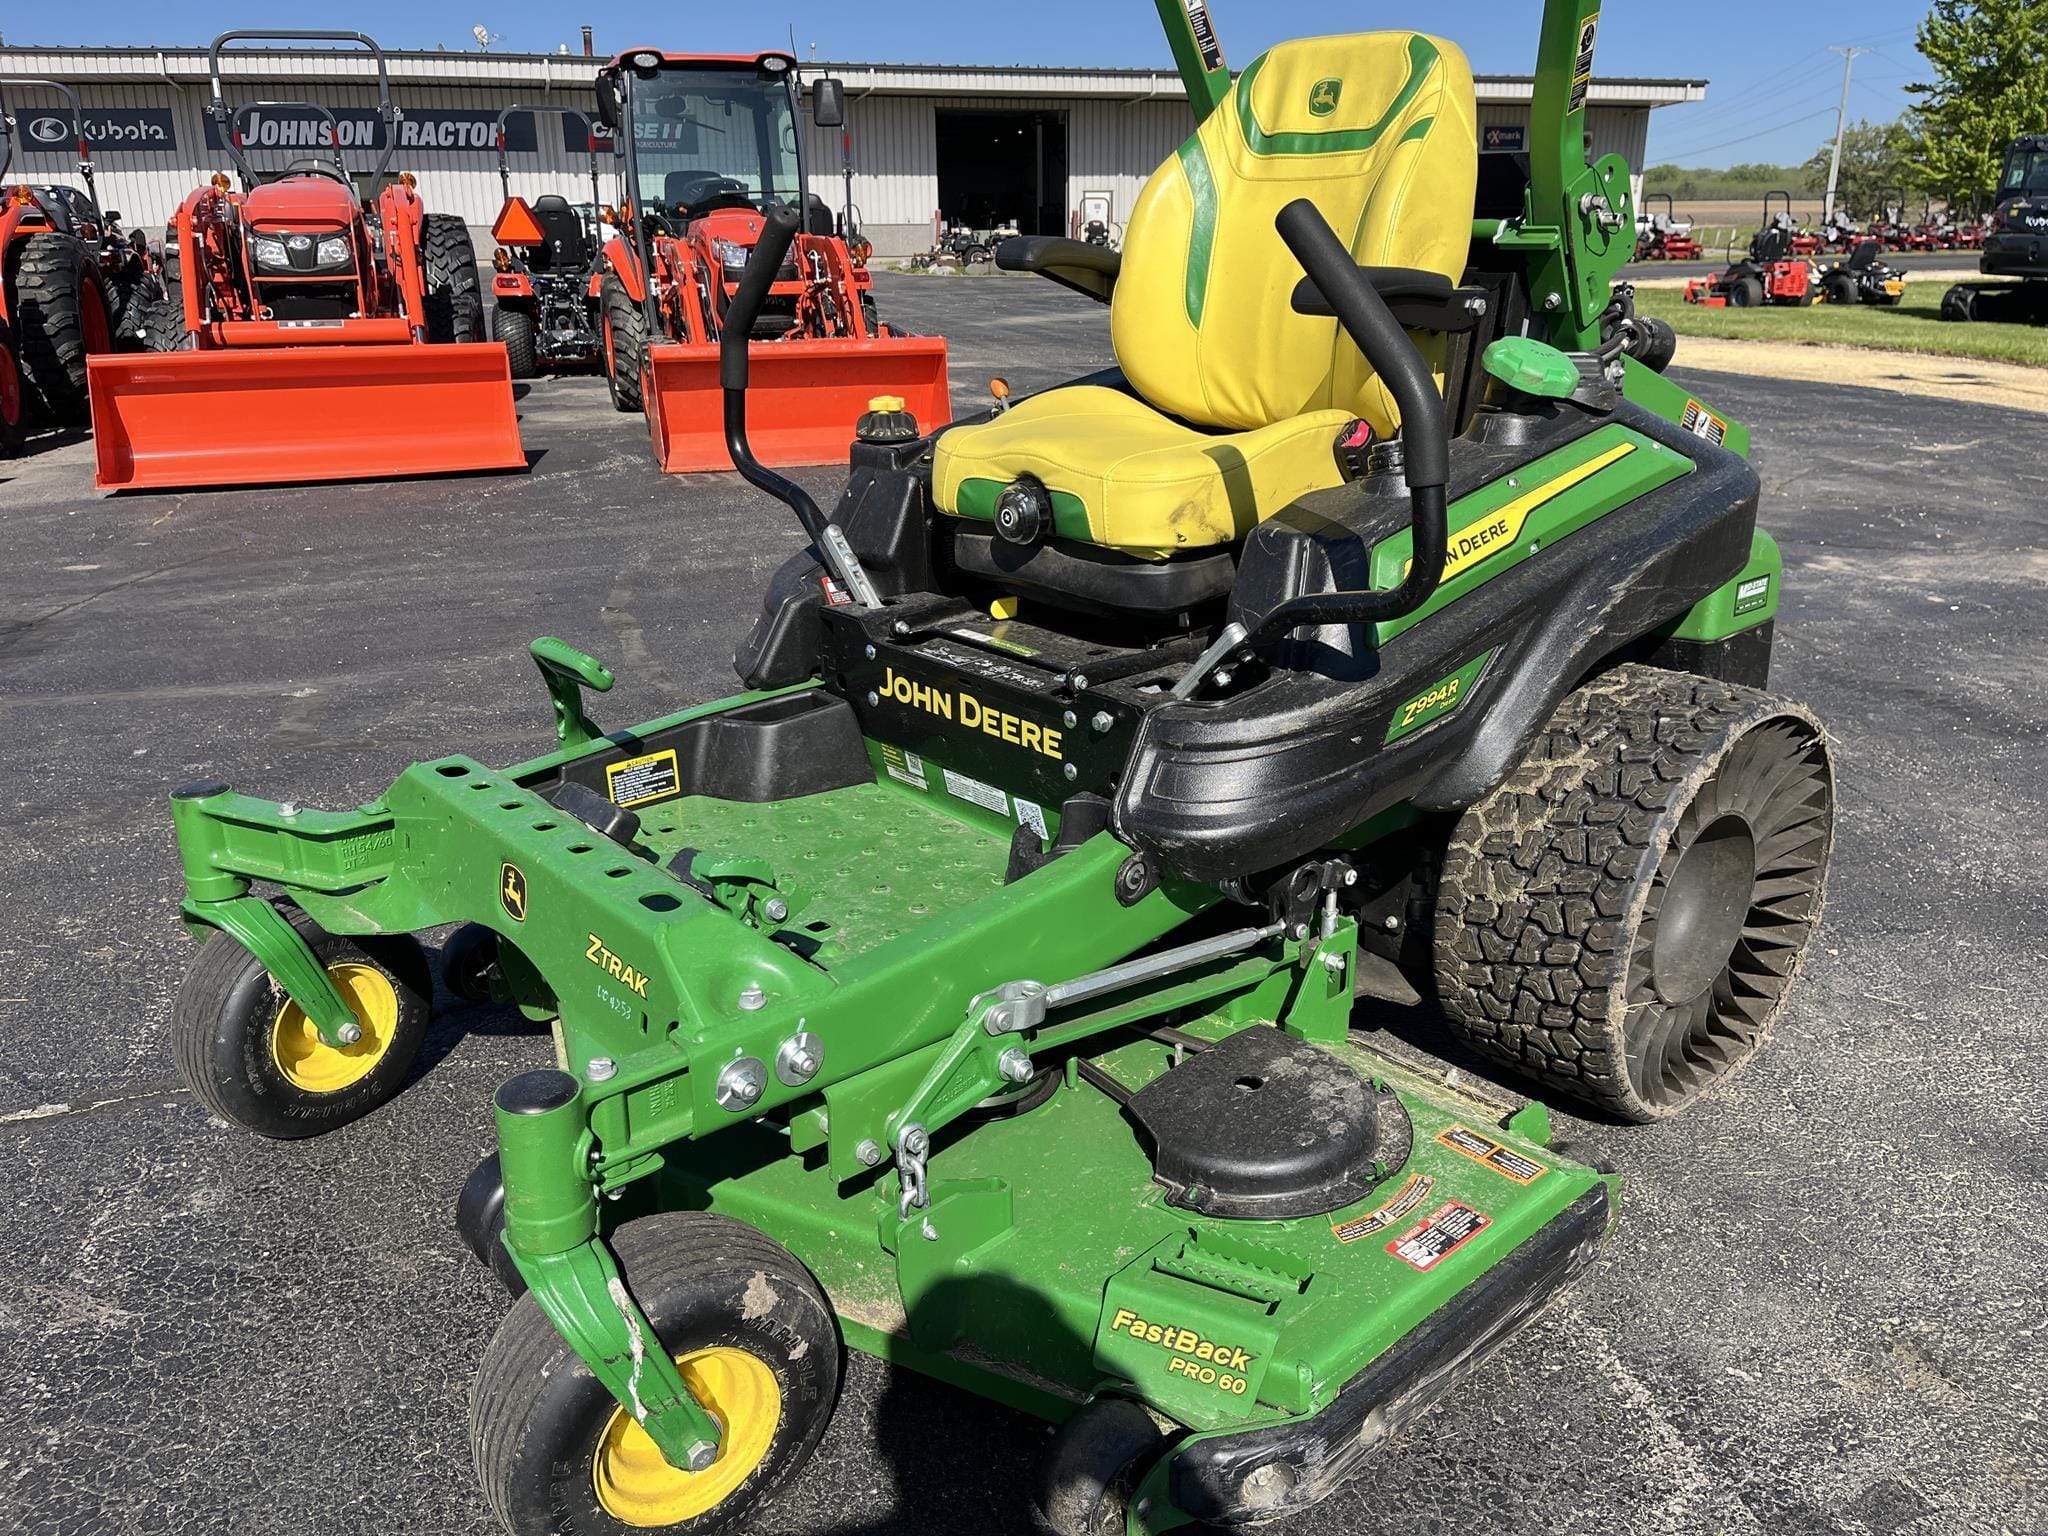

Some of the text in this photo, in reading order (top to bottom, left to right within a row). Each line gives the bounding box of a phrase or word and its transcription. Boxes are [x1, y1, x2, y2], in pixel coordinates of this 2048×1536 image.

[72, 119, 165, 141] Kubota
[241, 111, 374, 147] JOHNSON
[1458, 519, 1509, 557] DEERE
[879, 666, 952, 720] JOHN
[959, 692, 1063, 760] DEERE
[1401, 678, 1460, 727] Z994R
[585, 932, 650, 1001] ZTRAK
[1111, 1307, 1256, 1374] FastBack
[1167, 1355, 1248, 1396] PRO 60
